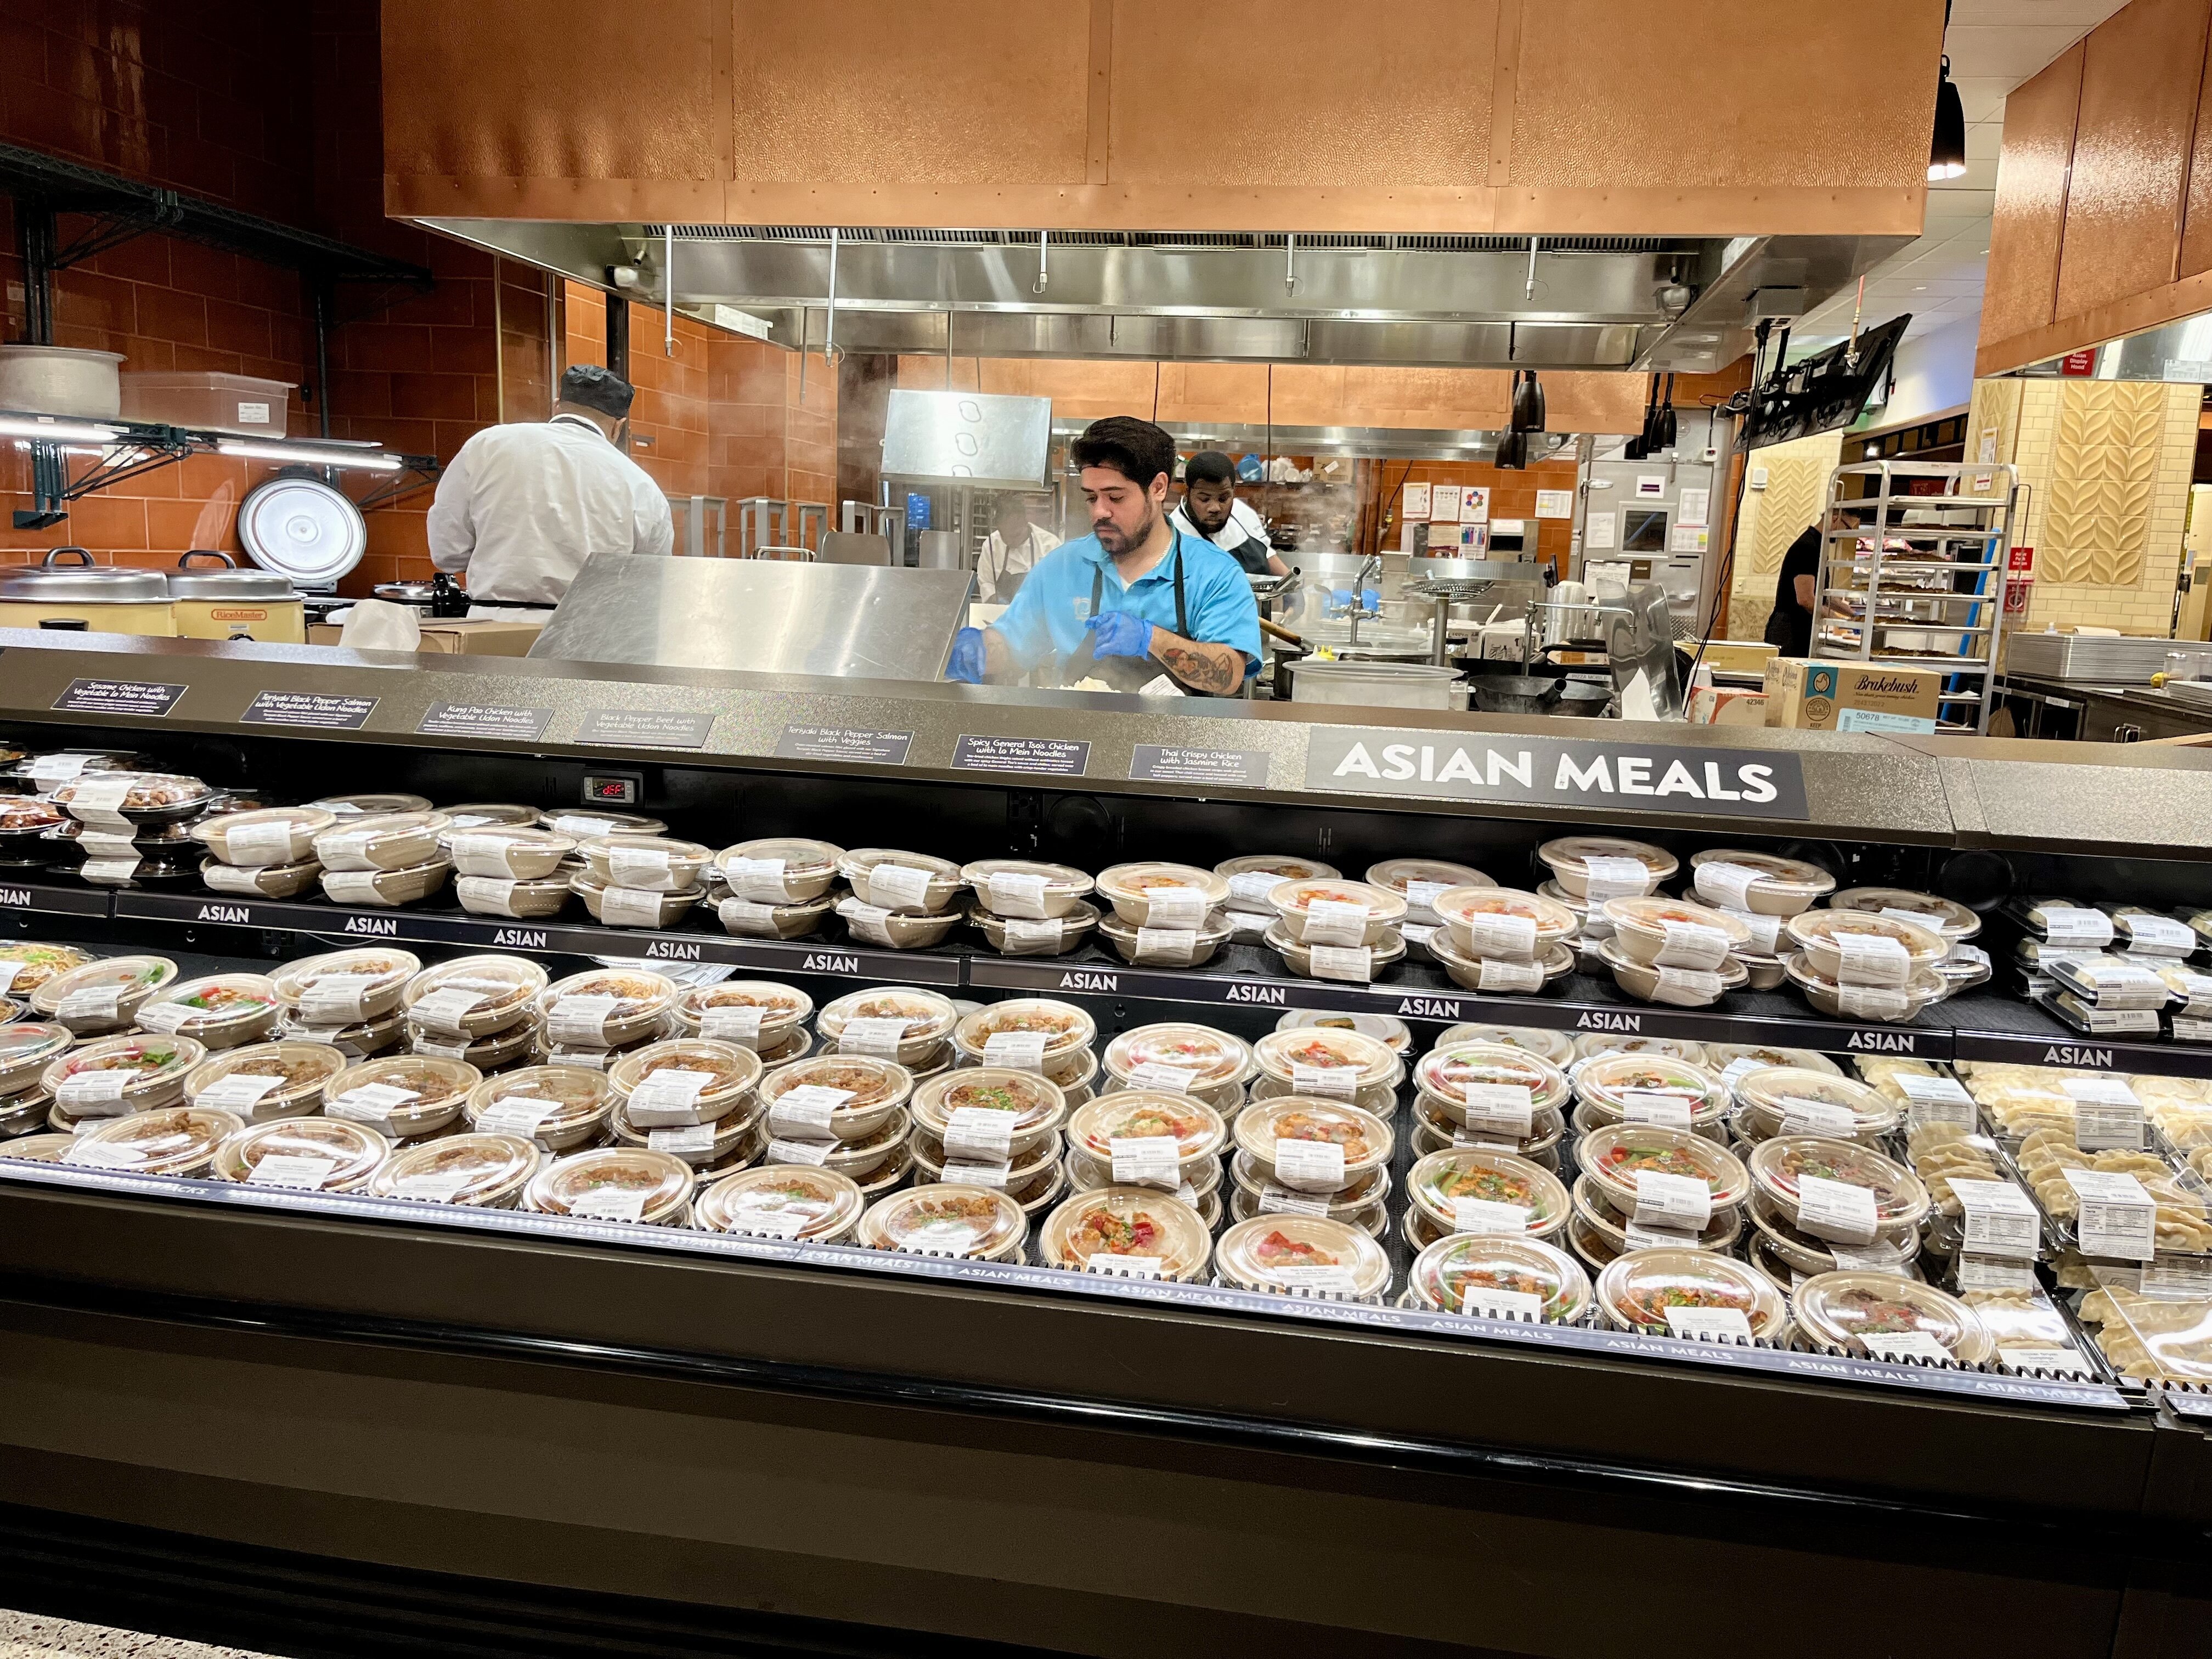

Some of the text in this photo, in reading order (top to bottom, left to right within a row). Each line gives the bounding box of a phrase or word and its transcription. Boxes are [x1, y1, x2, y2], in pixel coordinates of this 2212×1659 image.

[74, 689, 109, 697] Vegetable
[119, 684, 146, 692] Chicken
[1854, 674, 1917, 694] Brakebush
[262, 693, 290, 702] Teriyaki
[313, 697, 341, 705] Pepper
[342, 698, 372, 707] Salmon
[276, 702, 313, 710] Vegetable
[439, 712, 476, 721] Vegetable
[503, 715, 534, 724] Noodles
[447, 705, 467, 714] Kung
[485, 708, 514, 716] Chicken
[624, 715, 653, 724] Pepper
[1857, 713, 1880, 721] 50678
[596, 721, 635, 730] Vegetable
[788, 726, 817, 735] Teriyaki
[844, 730, 874, 739] Pepper
[876, 732, 907, 741] Salmon
[841, 738, 871, 746] Veggies
[968, 738, 1079, 751] Spicy General Tso's Chicken
[1032, 749, 1066, 758] Noodles
[1181, 750, 1207, 760] Crispy
[1210, 752, 1242, 760] Chicken
[1333, 741, 1779, 803] ASIAN MEALS
[198, 905, 249, 923] ASIAN
[345, 917, 396, 935] ASIAN
[494, 929, 546, 947] ASIAN
[646, 941, 700, 960] ASIAN
[803, 954, 857, 973] ASIAN
[1060, 972, 1117, 991] ASIAN
[1226, 985, 1285, 1004] ASIAN
[1398, 998, 1459, 1017] ASIAN
[1577, 1012, 1640, 1031] ASIAN
[1847, 1032, 1914, 1052] ASIAN
[2044, 1046, 2112, 1066] ASIAN
[803, 1250, 913, 1269] ASIAN MEALS
[957, 1267, 1072, 1286] ASIAN MEALS
[1117, 1283, 1234, 1306] ASIAN MEALS
[1281, 1302, 1401, 1324] ASIAN MEALS
[1429, 1319, 1554, 1341] ASIAN MEALS
[1606, 1339, 1734, 1362] ASIAN MEALS
[1788, 1359, 1920, 1384] ASIAN MEALS
[1974, 1381, 2109, 1402] ASIAN MEALS
